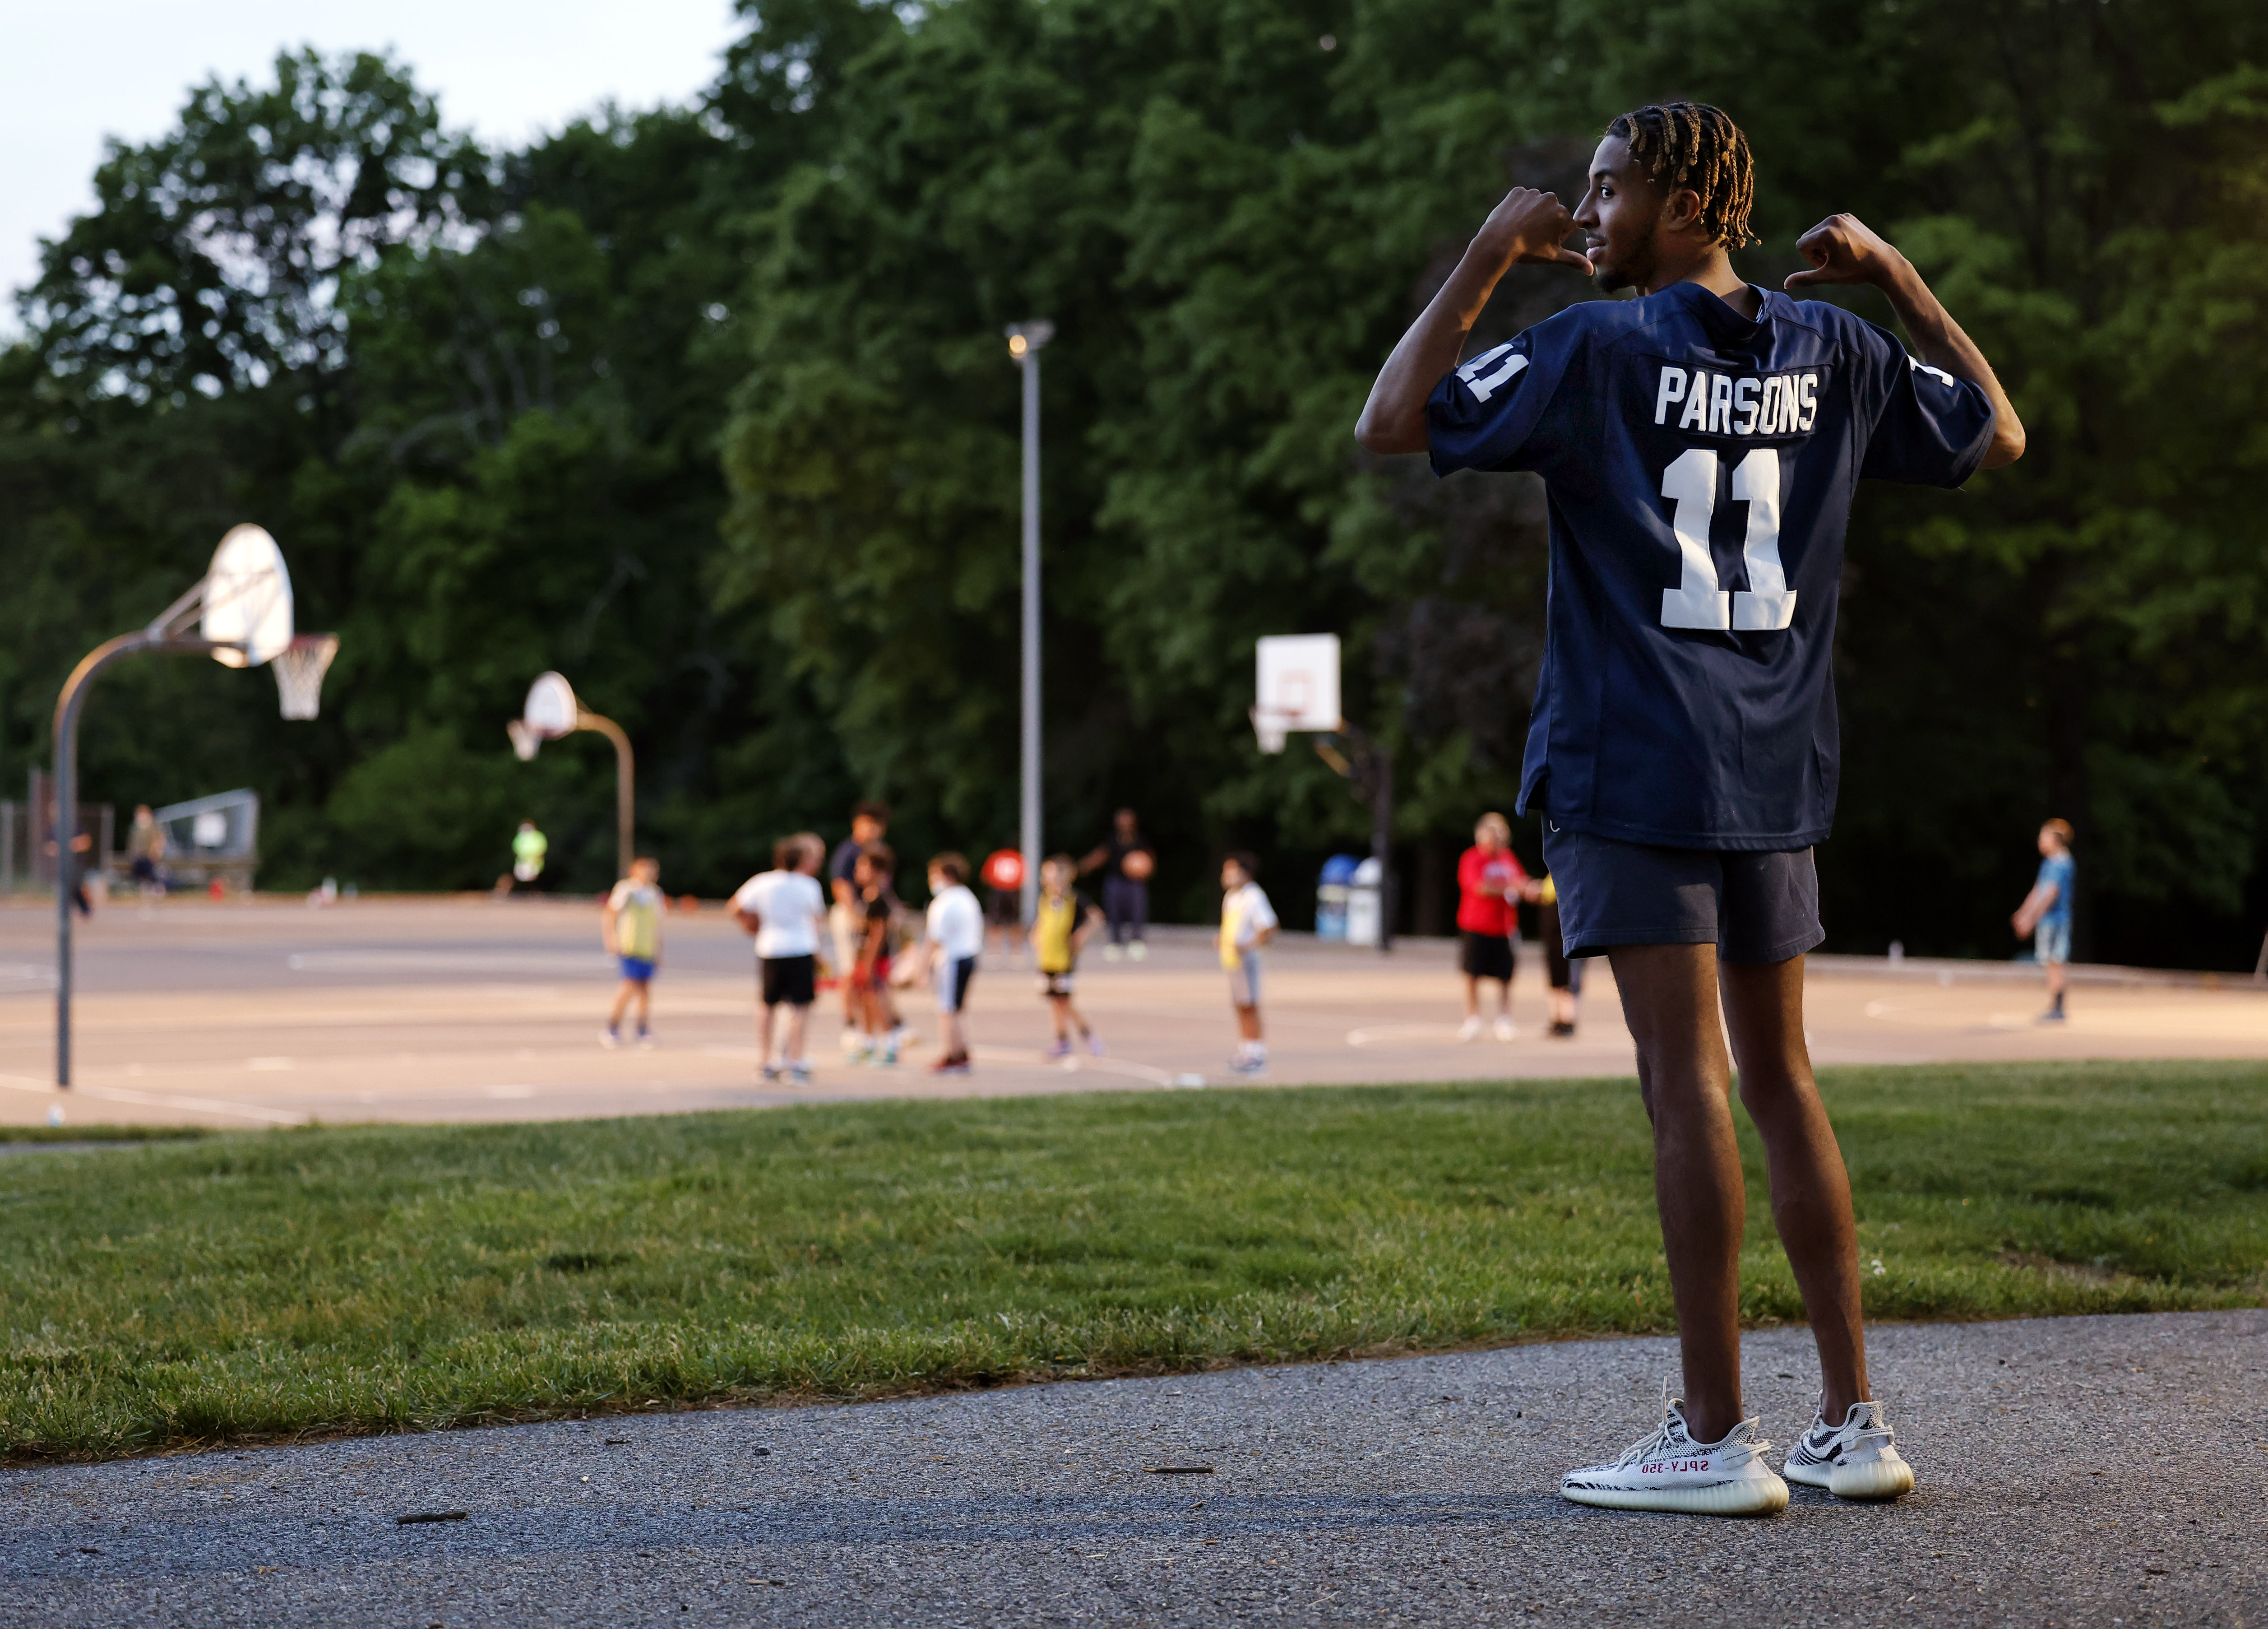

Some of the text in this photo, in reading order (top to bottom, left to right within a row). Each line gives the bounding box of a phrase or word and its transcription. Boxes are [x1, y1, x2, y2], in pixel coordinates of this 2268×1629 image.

[1455, 343, 1529, 403] 11
[1655, 366, 1818, 435] PARSONS
[1661, 449, 1797, 631] 11
